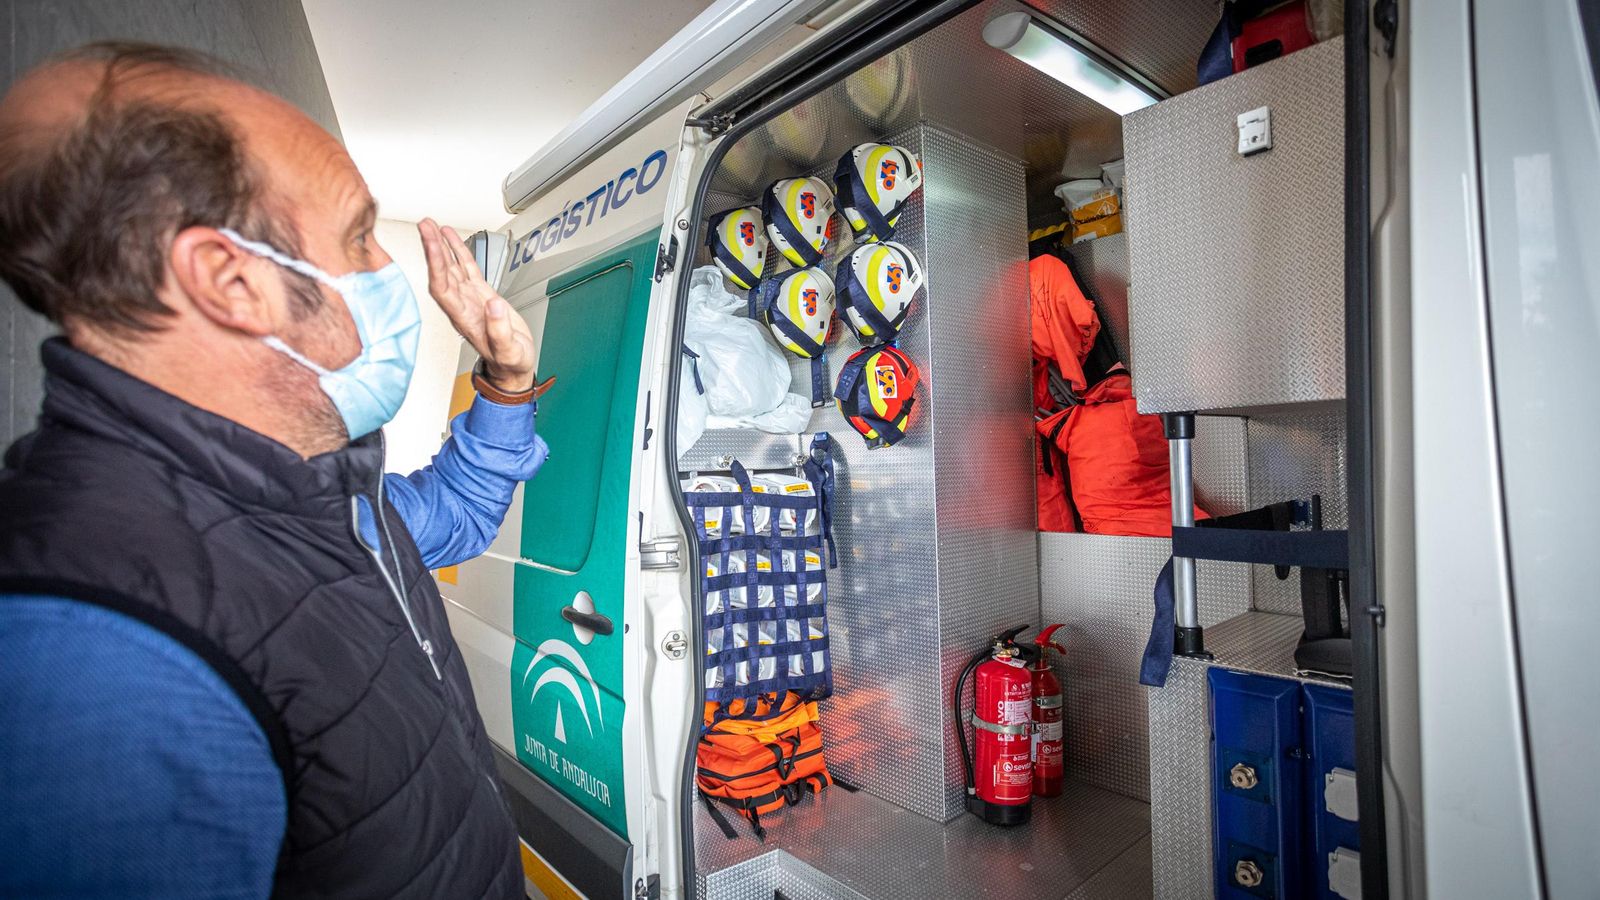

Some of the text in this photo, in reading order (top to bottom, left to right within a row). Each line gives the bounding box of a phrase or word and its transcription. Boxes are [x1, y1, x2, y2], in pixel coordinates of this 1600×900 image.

[509, 149, 668, 272] LOGÍSTICO
[997, 700, 1005, 742] PLVO
[524, 734, 547, 764] JUNTA
[549, 749, 560, 774] DE
